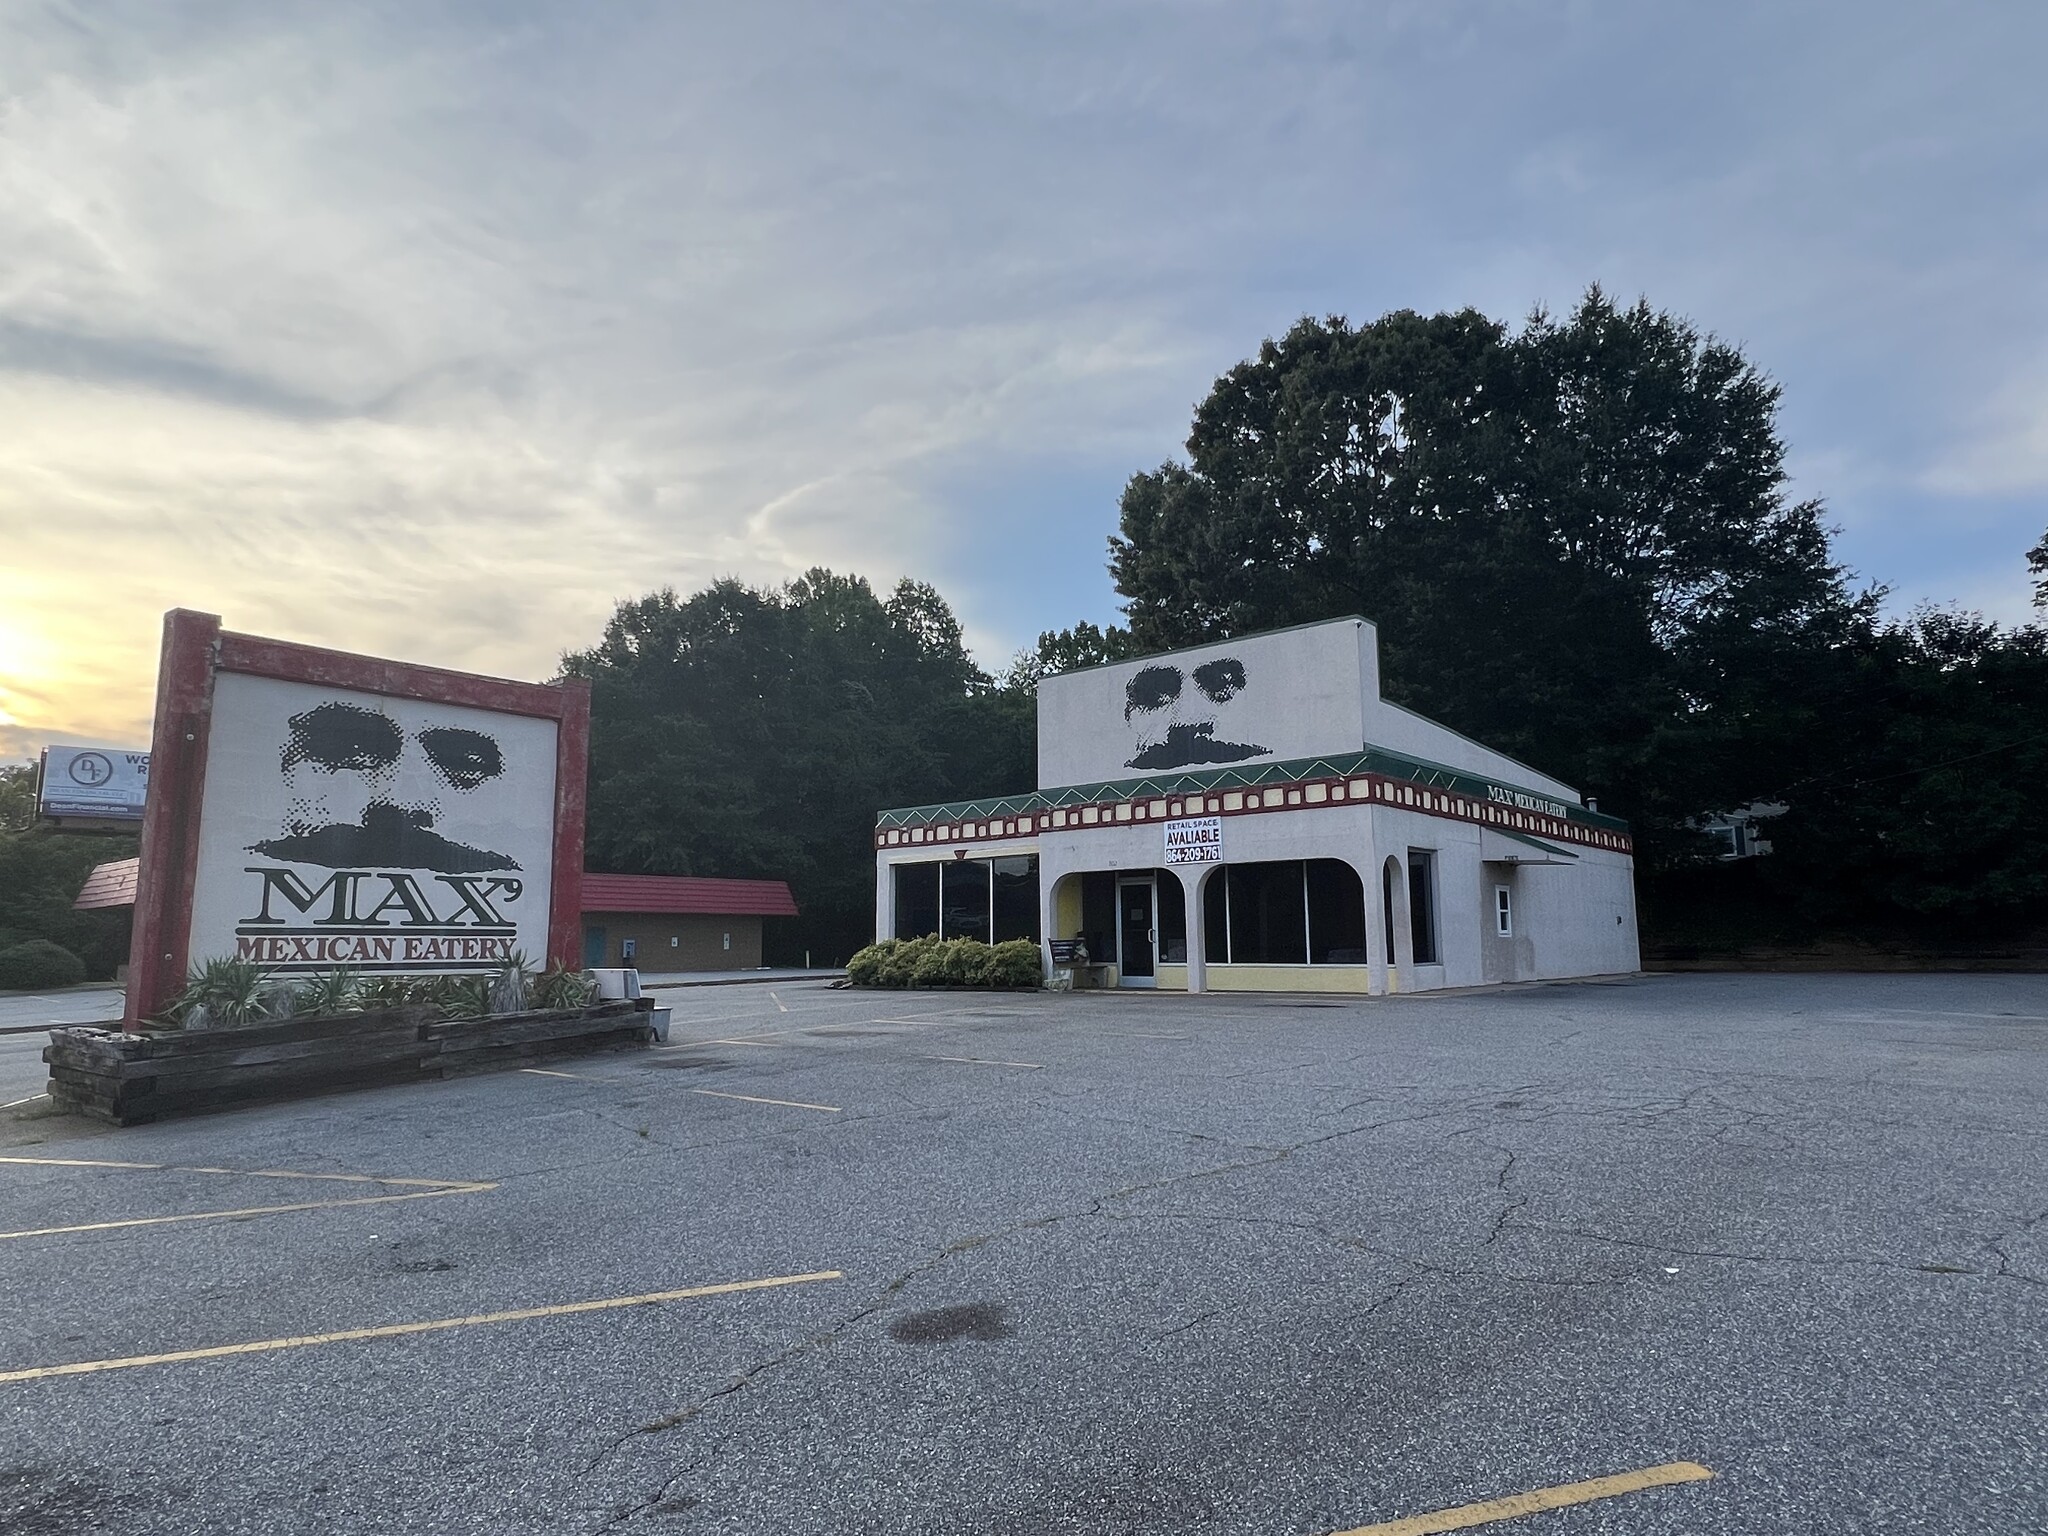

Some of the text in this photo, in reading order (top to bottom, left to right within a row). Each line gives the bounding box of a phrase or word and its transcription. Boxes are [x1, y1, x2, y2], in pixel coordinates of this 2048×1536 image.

[1514, 792, 1544, 813] MEXICAN
[1167, 819, 1219, 831] RETAIL SPACE
[1167, 828, 1220, 847] AVALIABLE
[235, 936, 518, 963] MEXICAN EATERY
